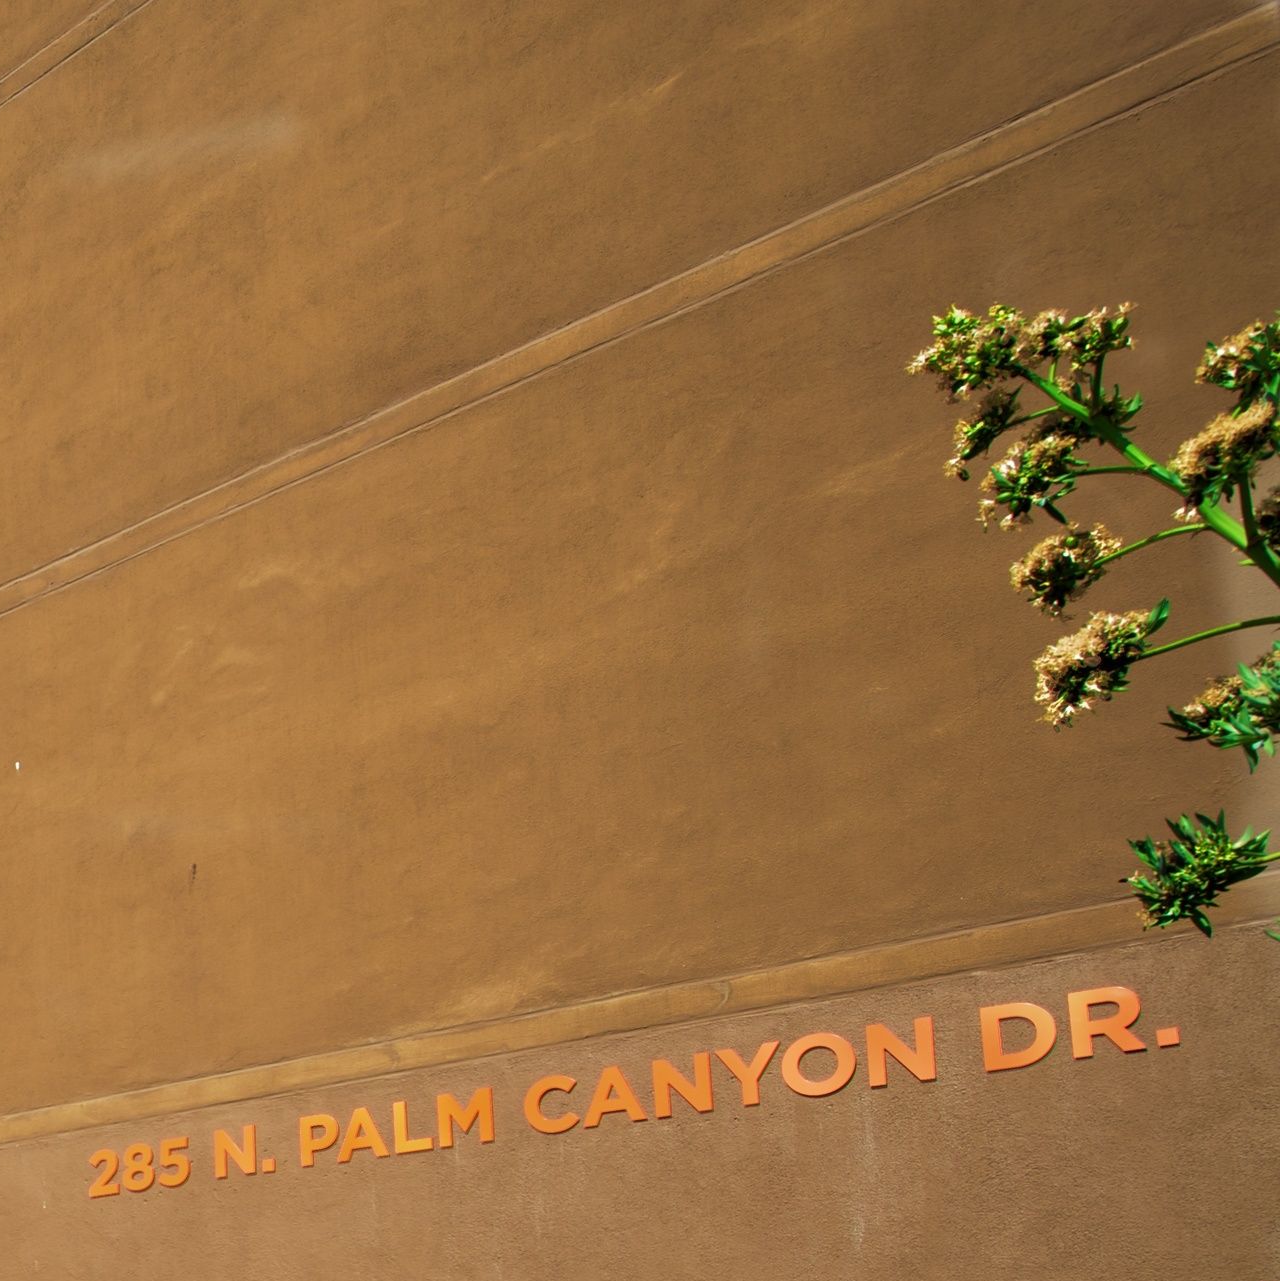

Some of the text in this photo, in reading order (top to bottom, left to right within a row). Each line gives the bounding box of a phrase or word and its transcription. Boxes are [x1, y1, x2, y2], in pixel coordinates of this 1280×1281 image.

[88, 986, 1181, 1197] 285 N. PALM CANYON DR.
